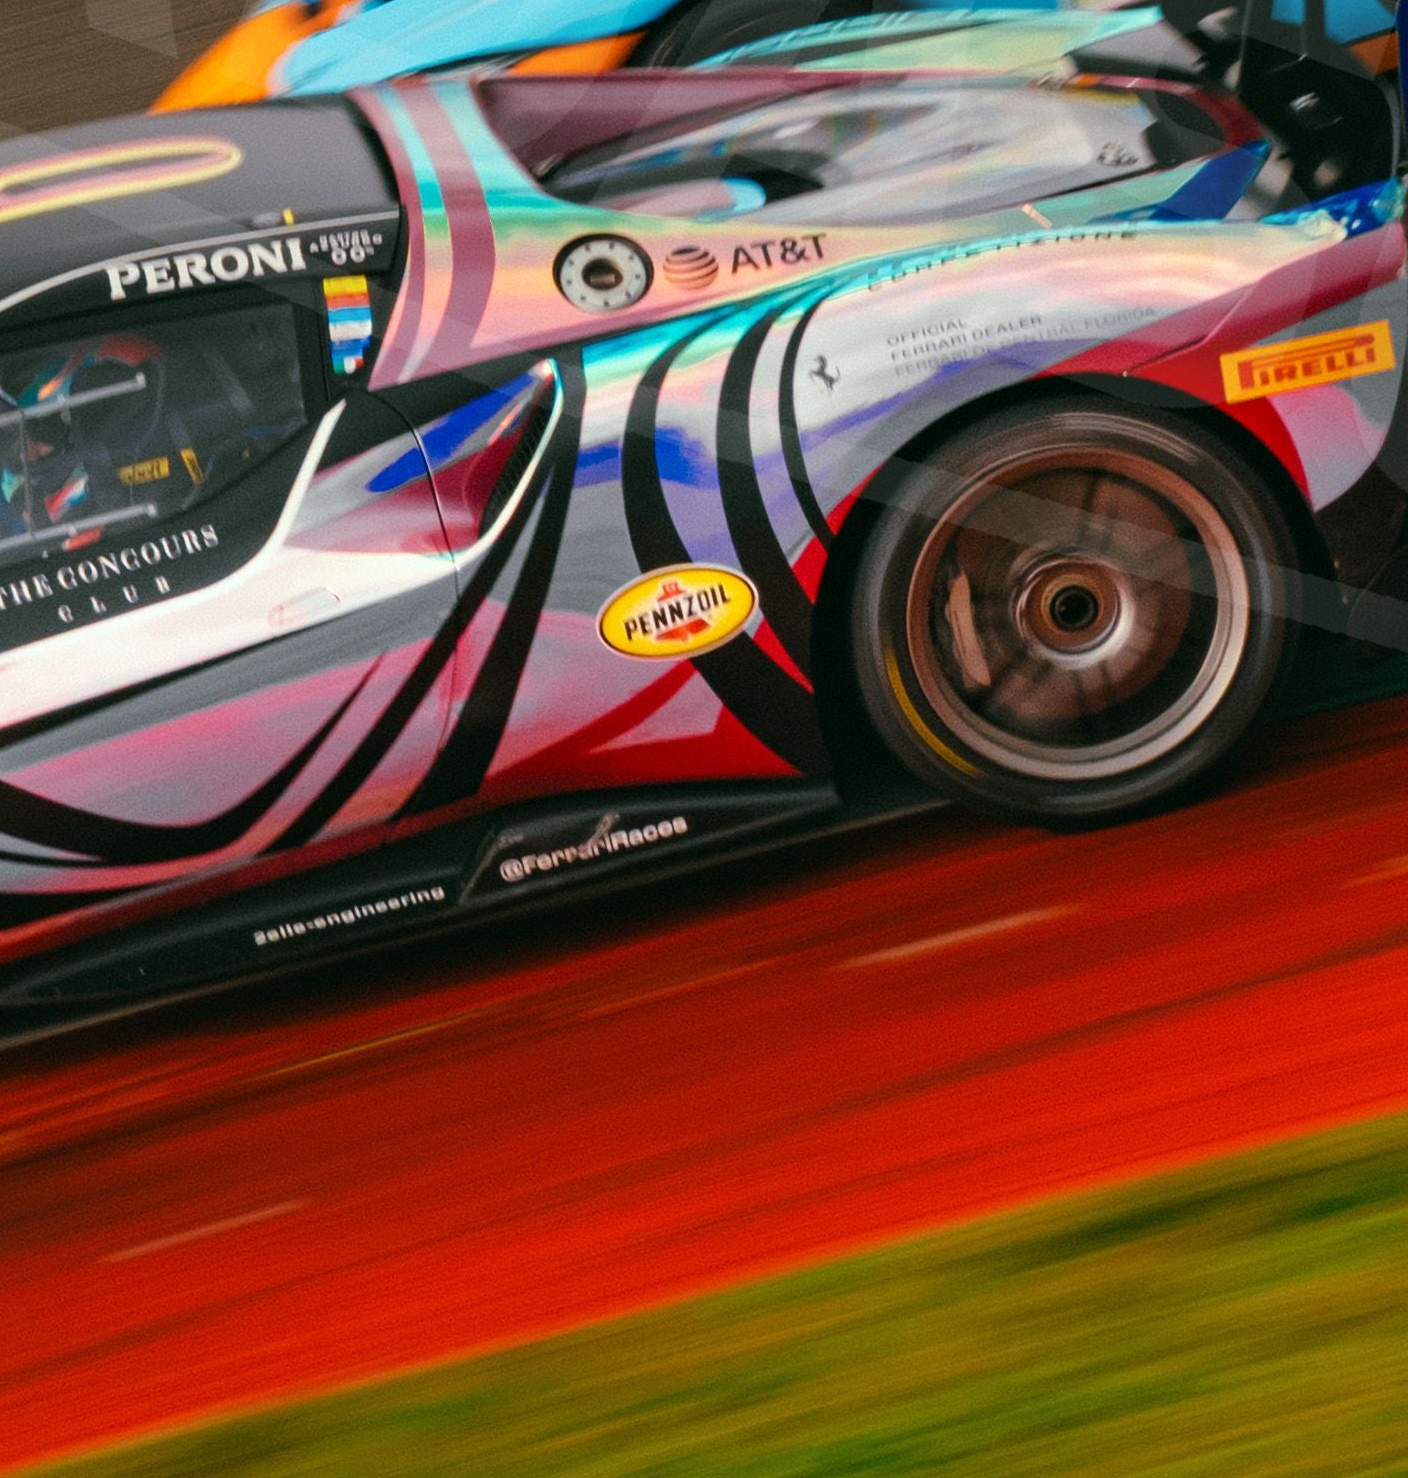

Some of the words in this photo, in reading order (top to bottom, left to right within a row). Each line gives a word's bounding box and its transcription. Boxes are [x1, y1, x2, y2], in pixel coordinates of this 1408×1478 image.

[105, 237, 307, 302] PERONI
[731, 232, 827, 275] AT&T
[887, 318, 968, 347] OFFICIAL
[890, 332, 968, 362] FERRARI
[971, 313, 1042, 341] DEALER
[1237, 333, 1375, 390] PIRELLI
[56, 524, 219, 591] CONCOURS
[57, 575, 171, 623] CLUB
[623, 583, 731, 642] PENNZOIL
[499, 816, 688, 883] @FerrariRaces
